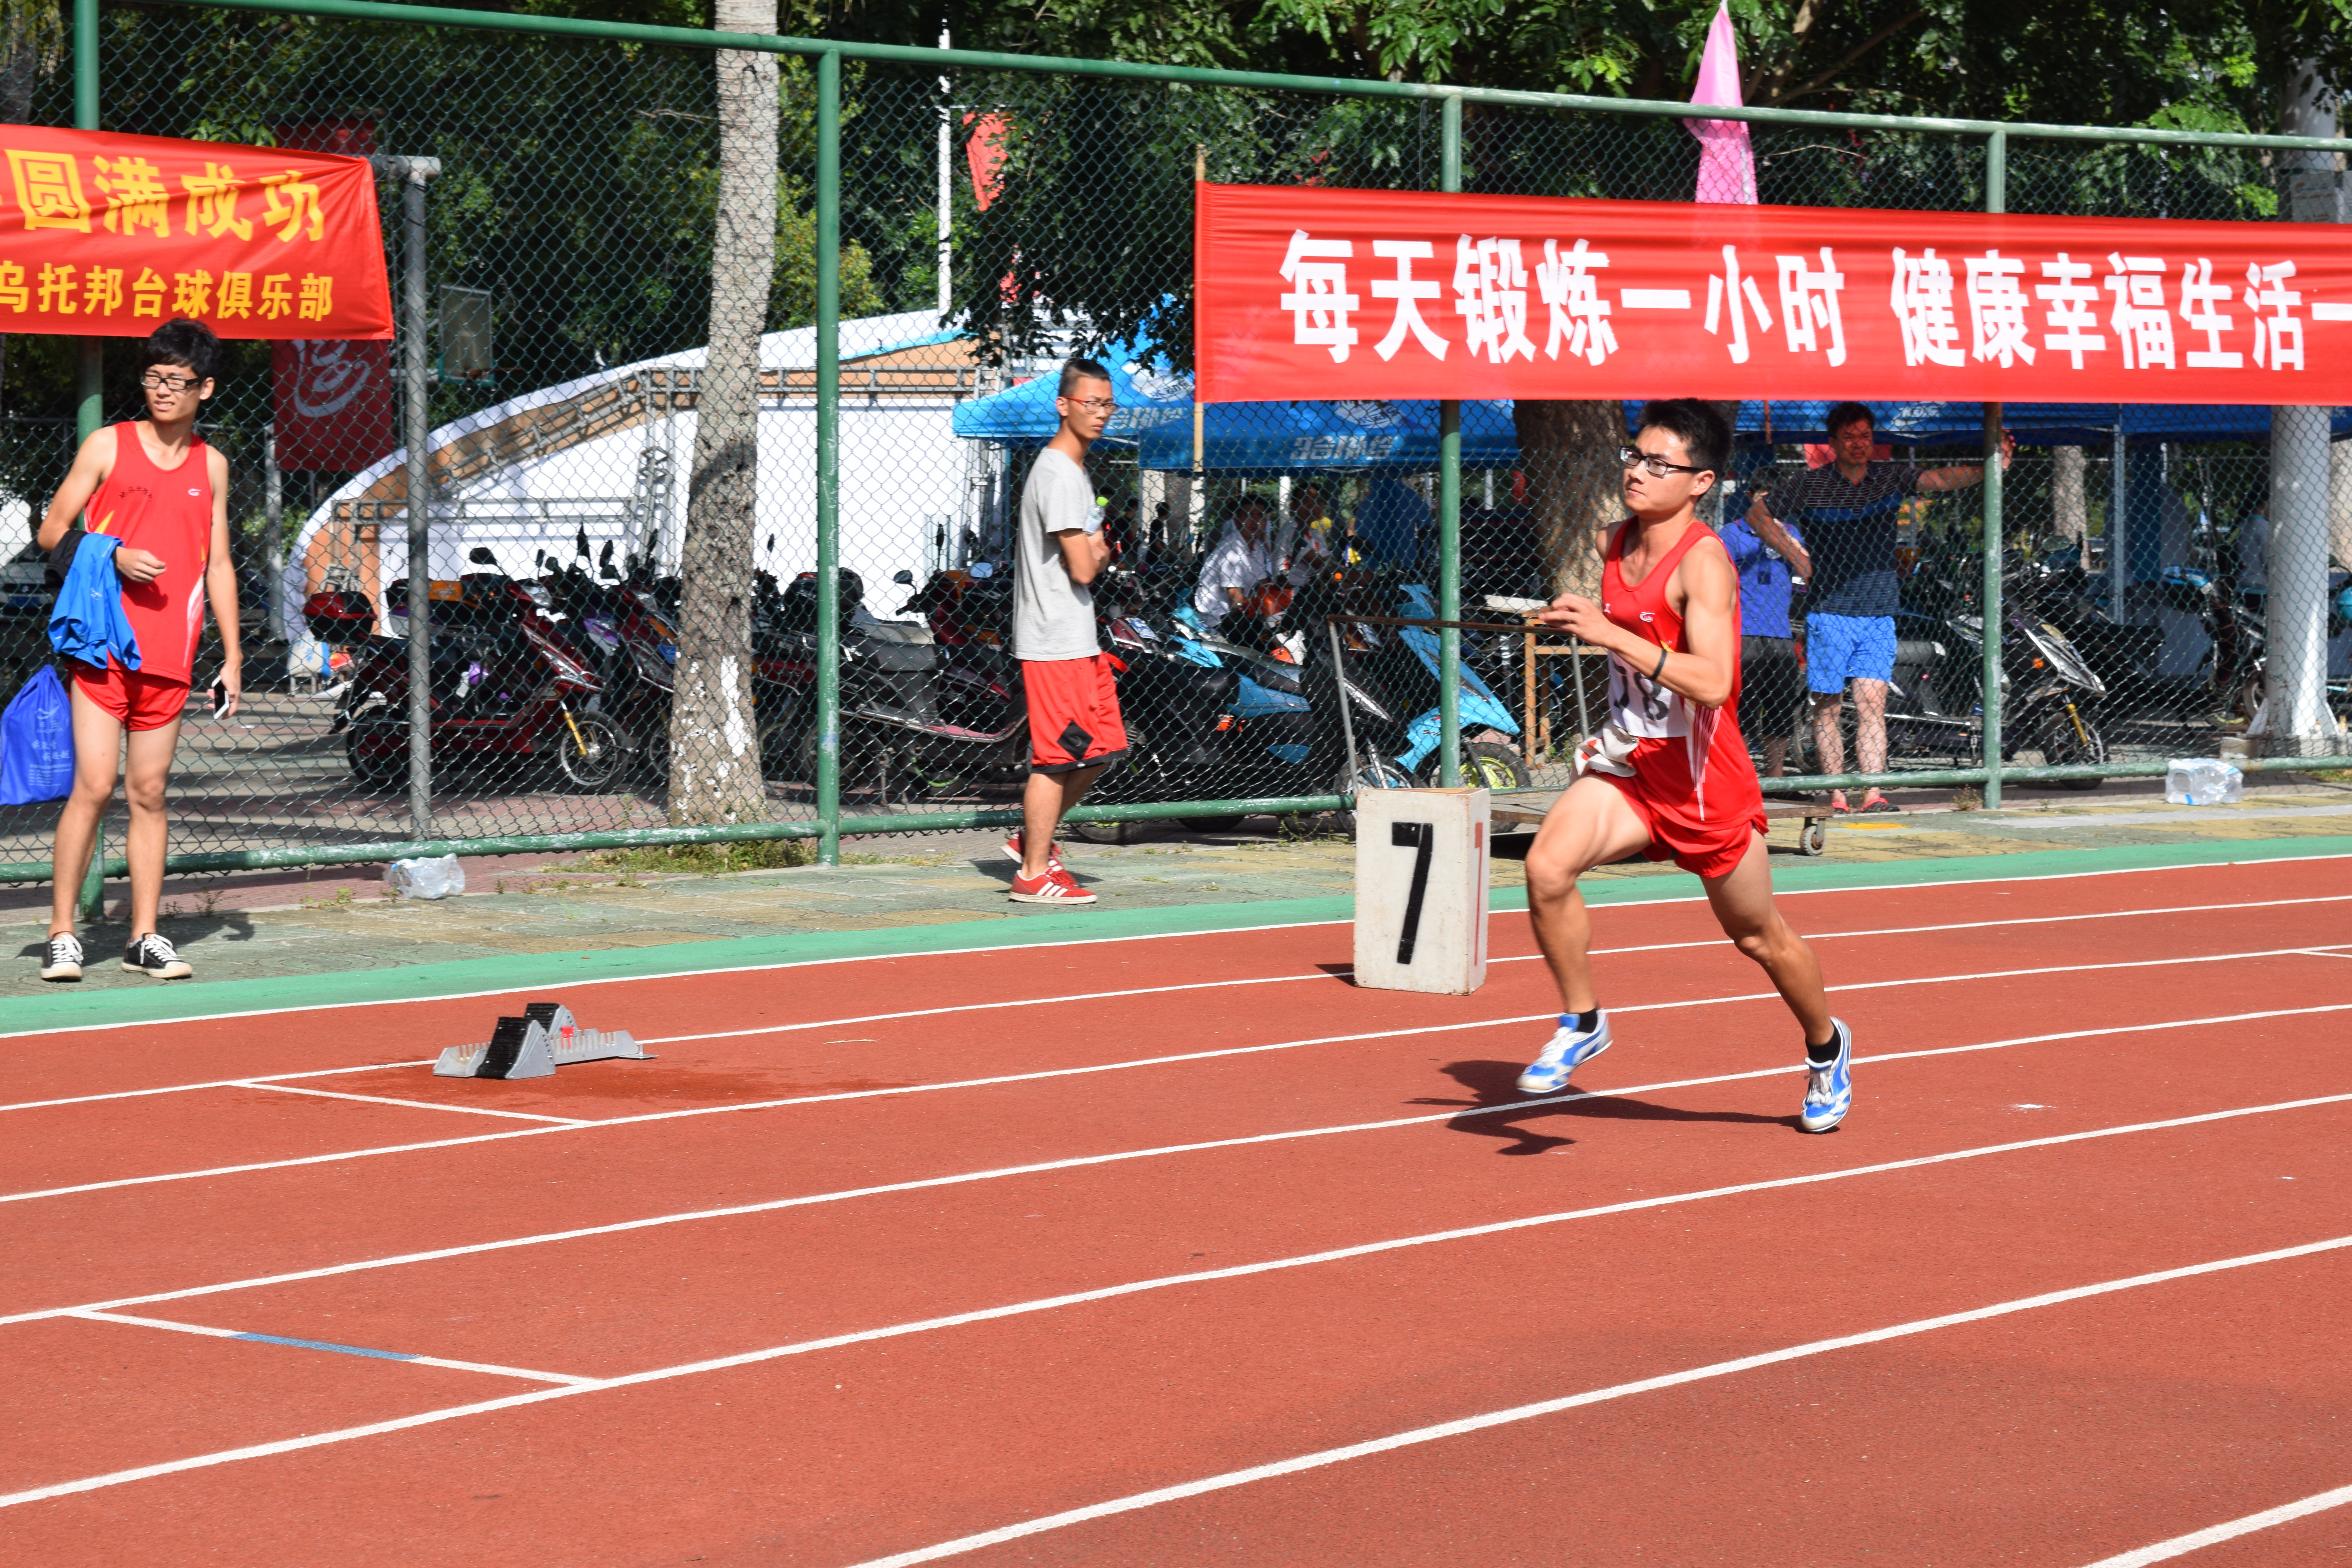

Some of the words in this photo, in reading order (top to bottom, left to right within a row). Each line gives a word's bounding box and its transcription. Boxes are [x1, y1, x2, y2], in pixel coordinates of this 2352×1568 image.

[0, 150, 324, 242] 圆满成功
[0, 260, 332, 321] 乌托邦台球俱乐部
[1279, 229, 1847, 367] 每天锻炼一小时
[1890, 247, 2352, 370] 健康幸福生活一
[1392, 822, 1433, 965] 7
